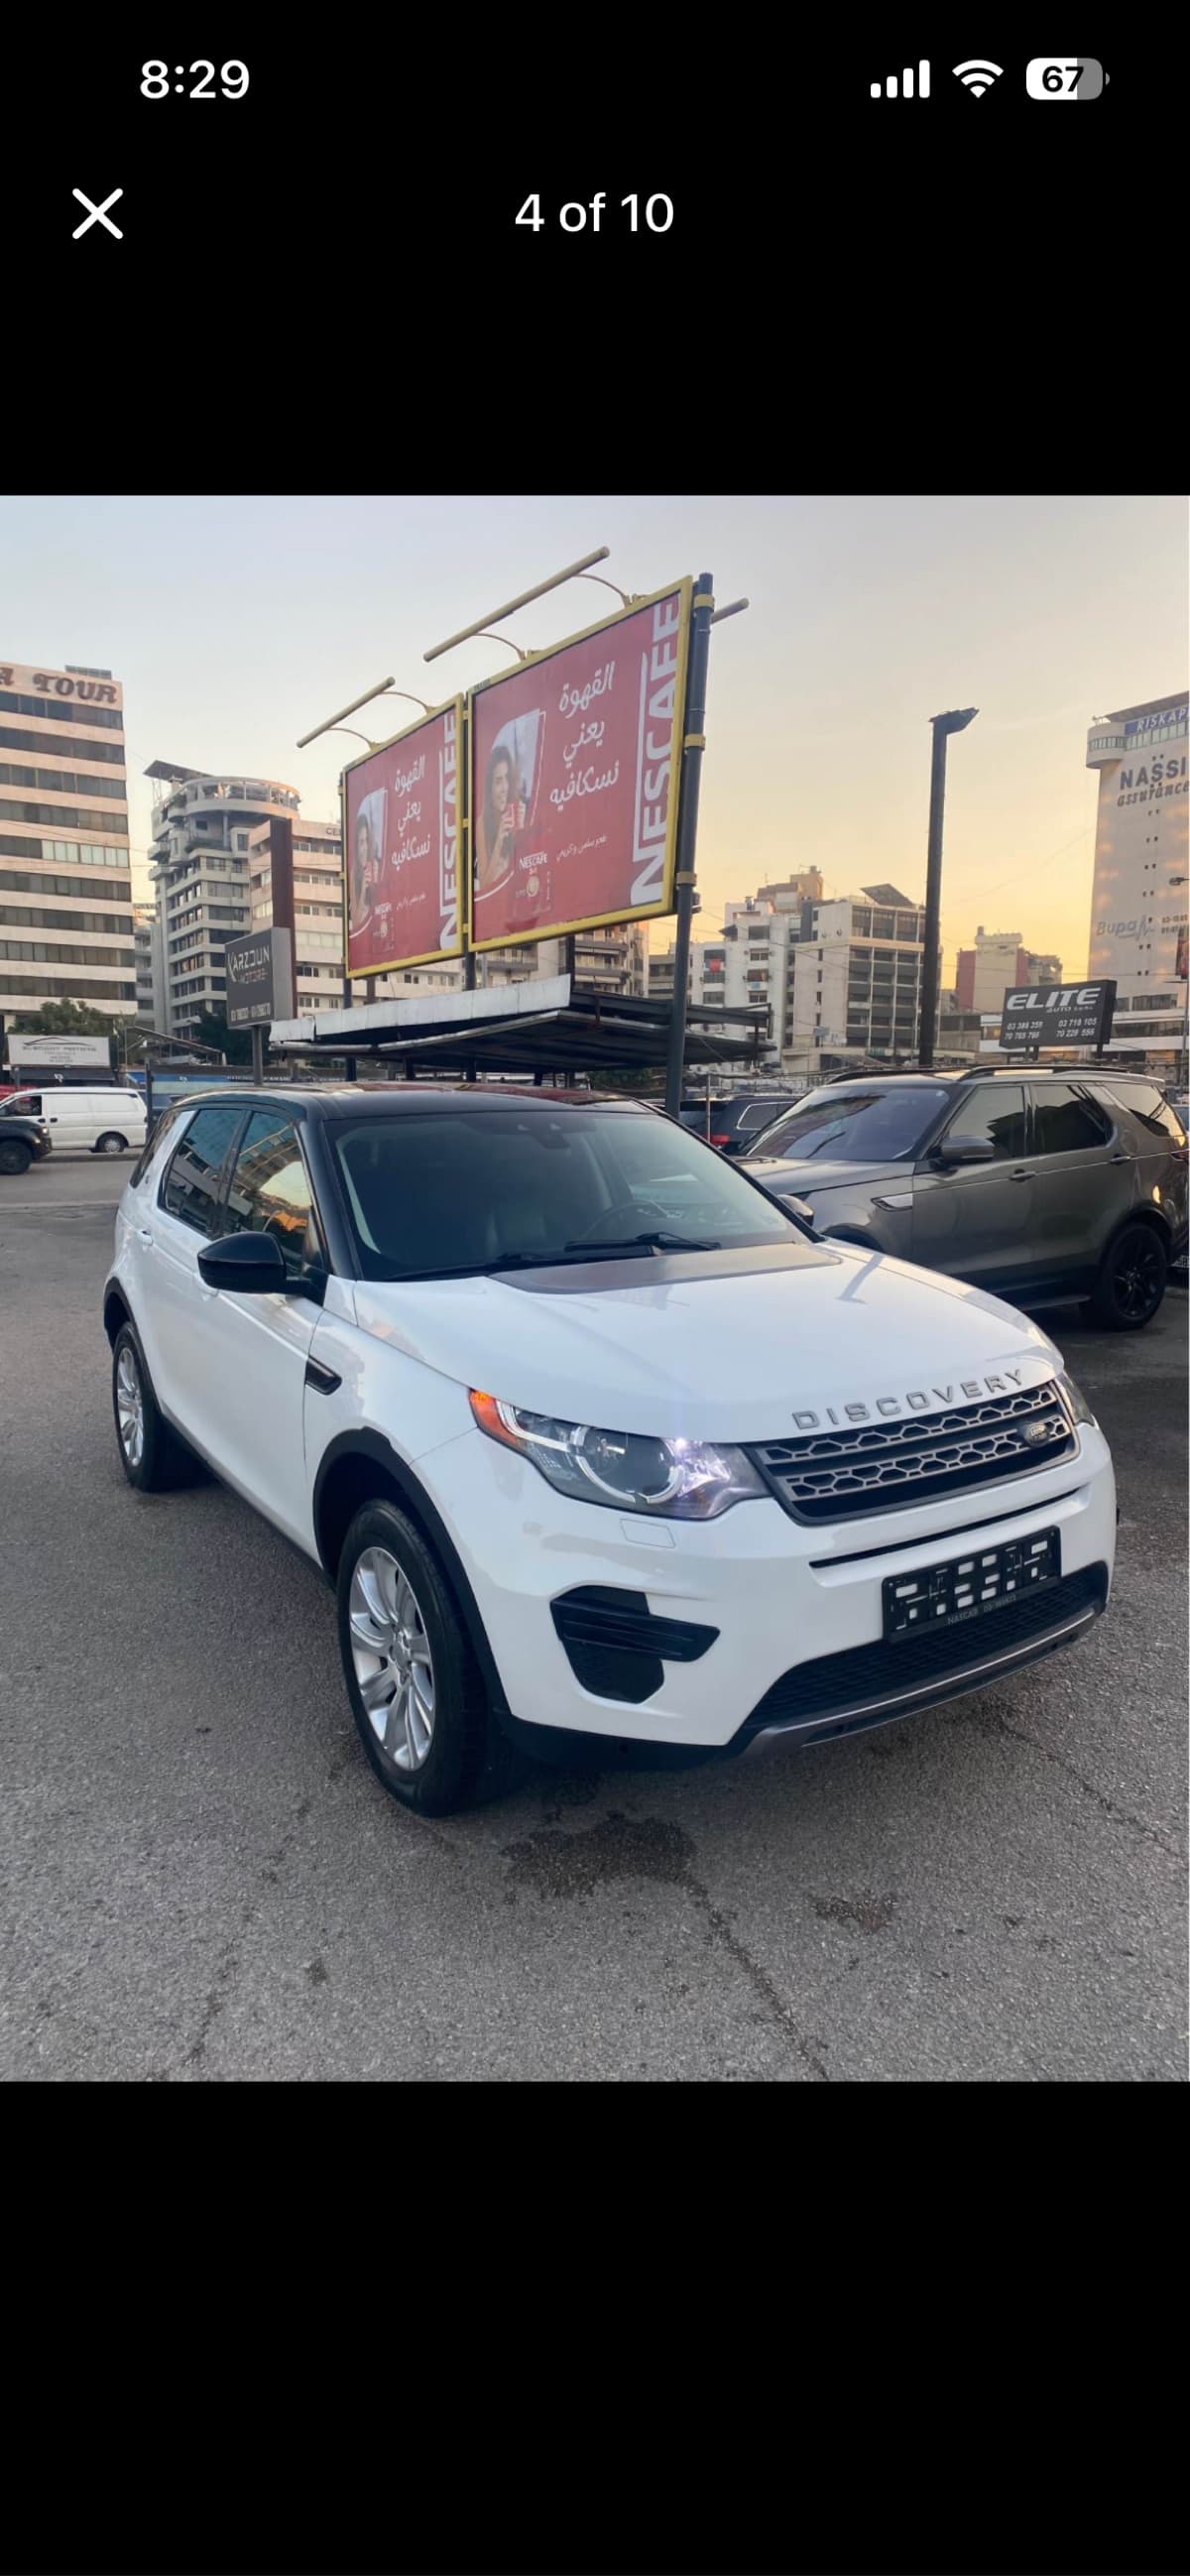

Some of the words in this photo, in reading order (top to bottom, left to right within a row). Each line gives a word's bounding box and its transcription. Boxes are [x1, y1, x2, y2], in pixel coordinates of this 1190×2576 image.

[32, 673, 118, 703] TOUR
[559, 661, 615, 719] القهوة
[1136, 707, 1189, 732] RISKAP
[562, 721, 605, 769] يعني
[395, 754, 425, 797] القهوة
[549, 760, 619, 811] نسكافيه
[398, 801, 421, 837] يعني
[391, 833, 430, 871] نسكافيه
[1007, 988, 1101, 1010] ELITE
[791, 1369, 1023, 1430] DISCOVERY
